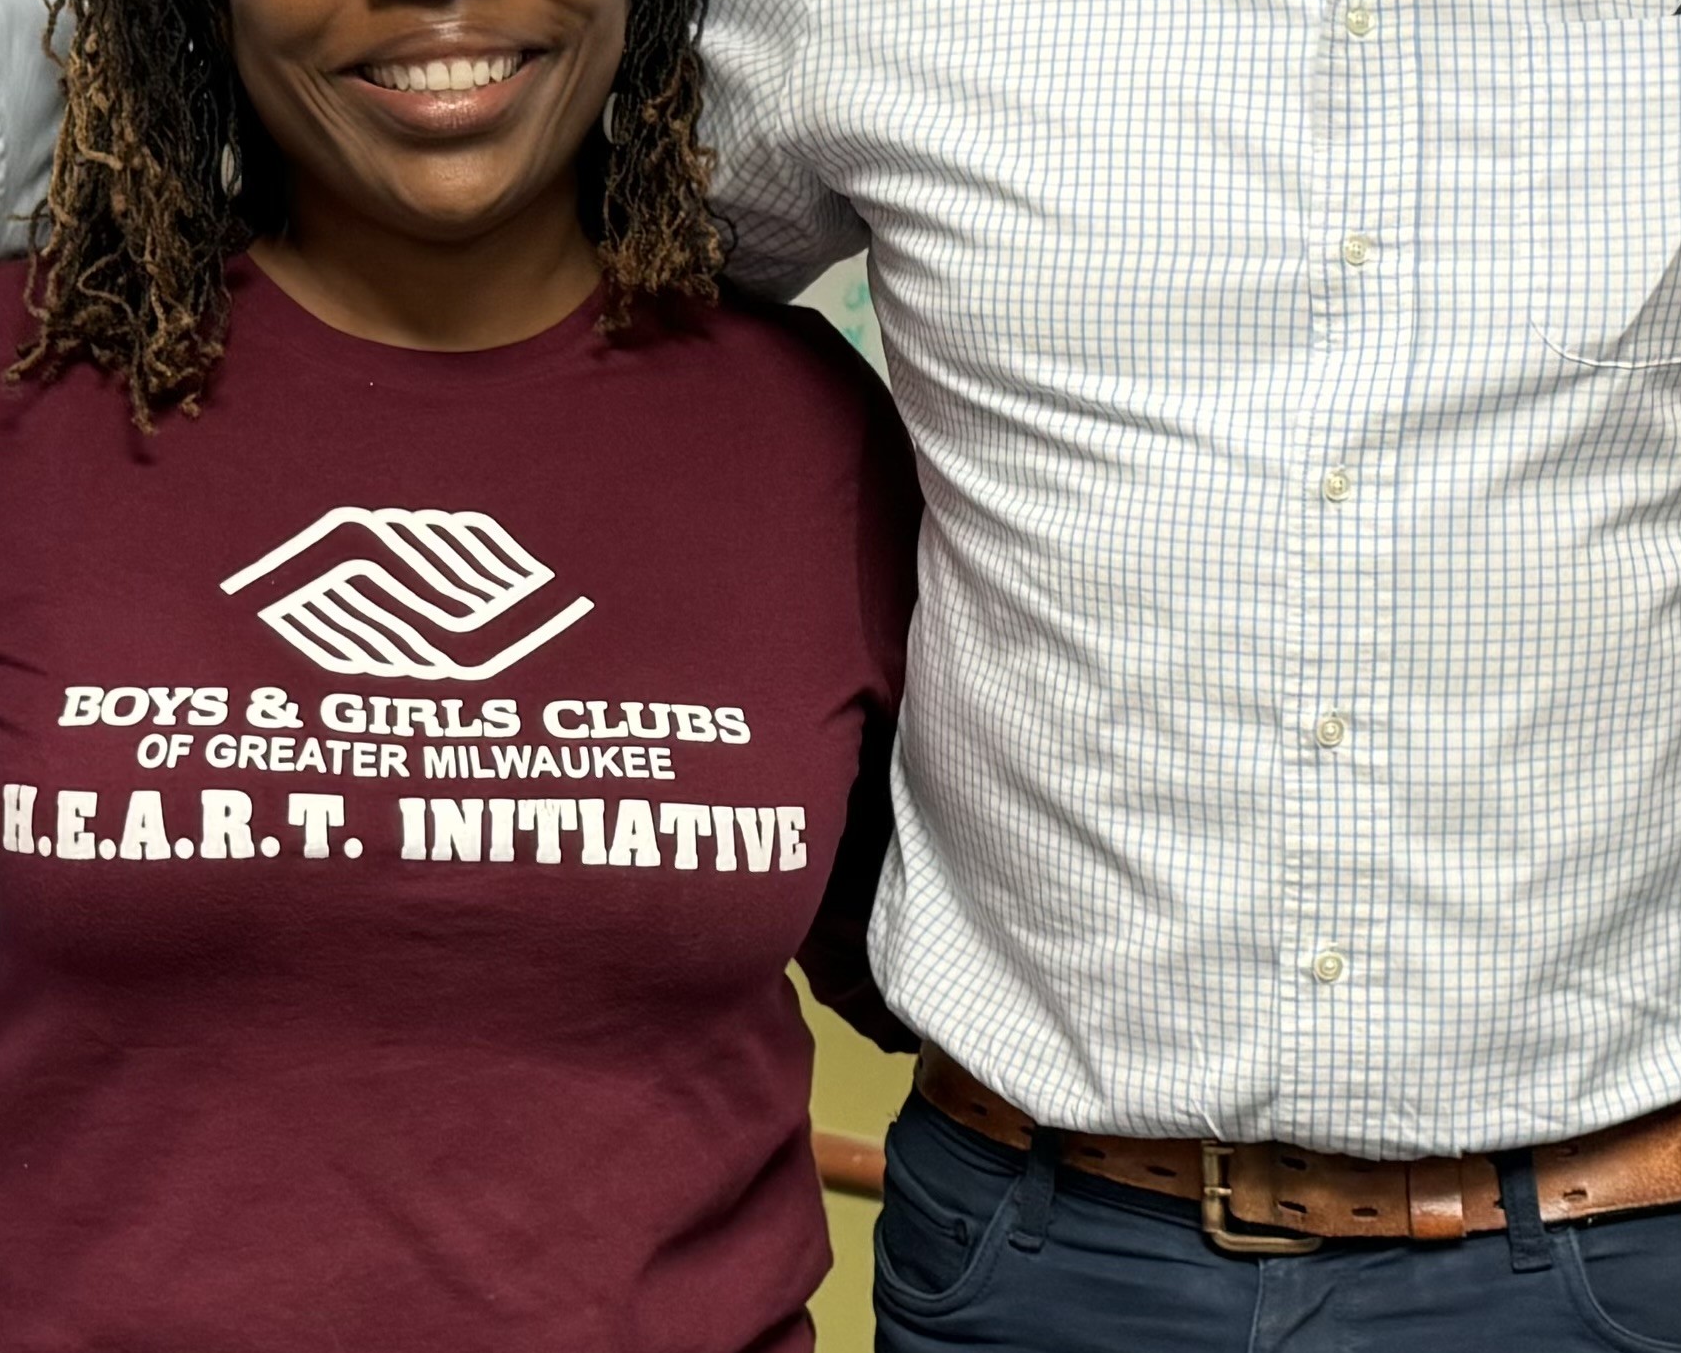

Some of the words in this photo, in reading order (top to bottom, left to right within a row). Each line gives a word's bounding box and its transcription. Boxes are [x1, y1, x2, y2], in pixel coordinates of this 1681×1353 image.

[58, 686, 229, 727] BOYS
[245, 686, 304, 729] &
[320, 693, 521, 739] GIRLS
[542, 699, 752, 744] CLUBS
[137, 733, 194, 769] OF
[205, 733, 410, 779] GREATER
[423, 744, 676, 780] MILWAUKEE
[2, 783, 364, 861] H.E.A.R.T.
[398, 797, 808, 873] INITIATIVE
